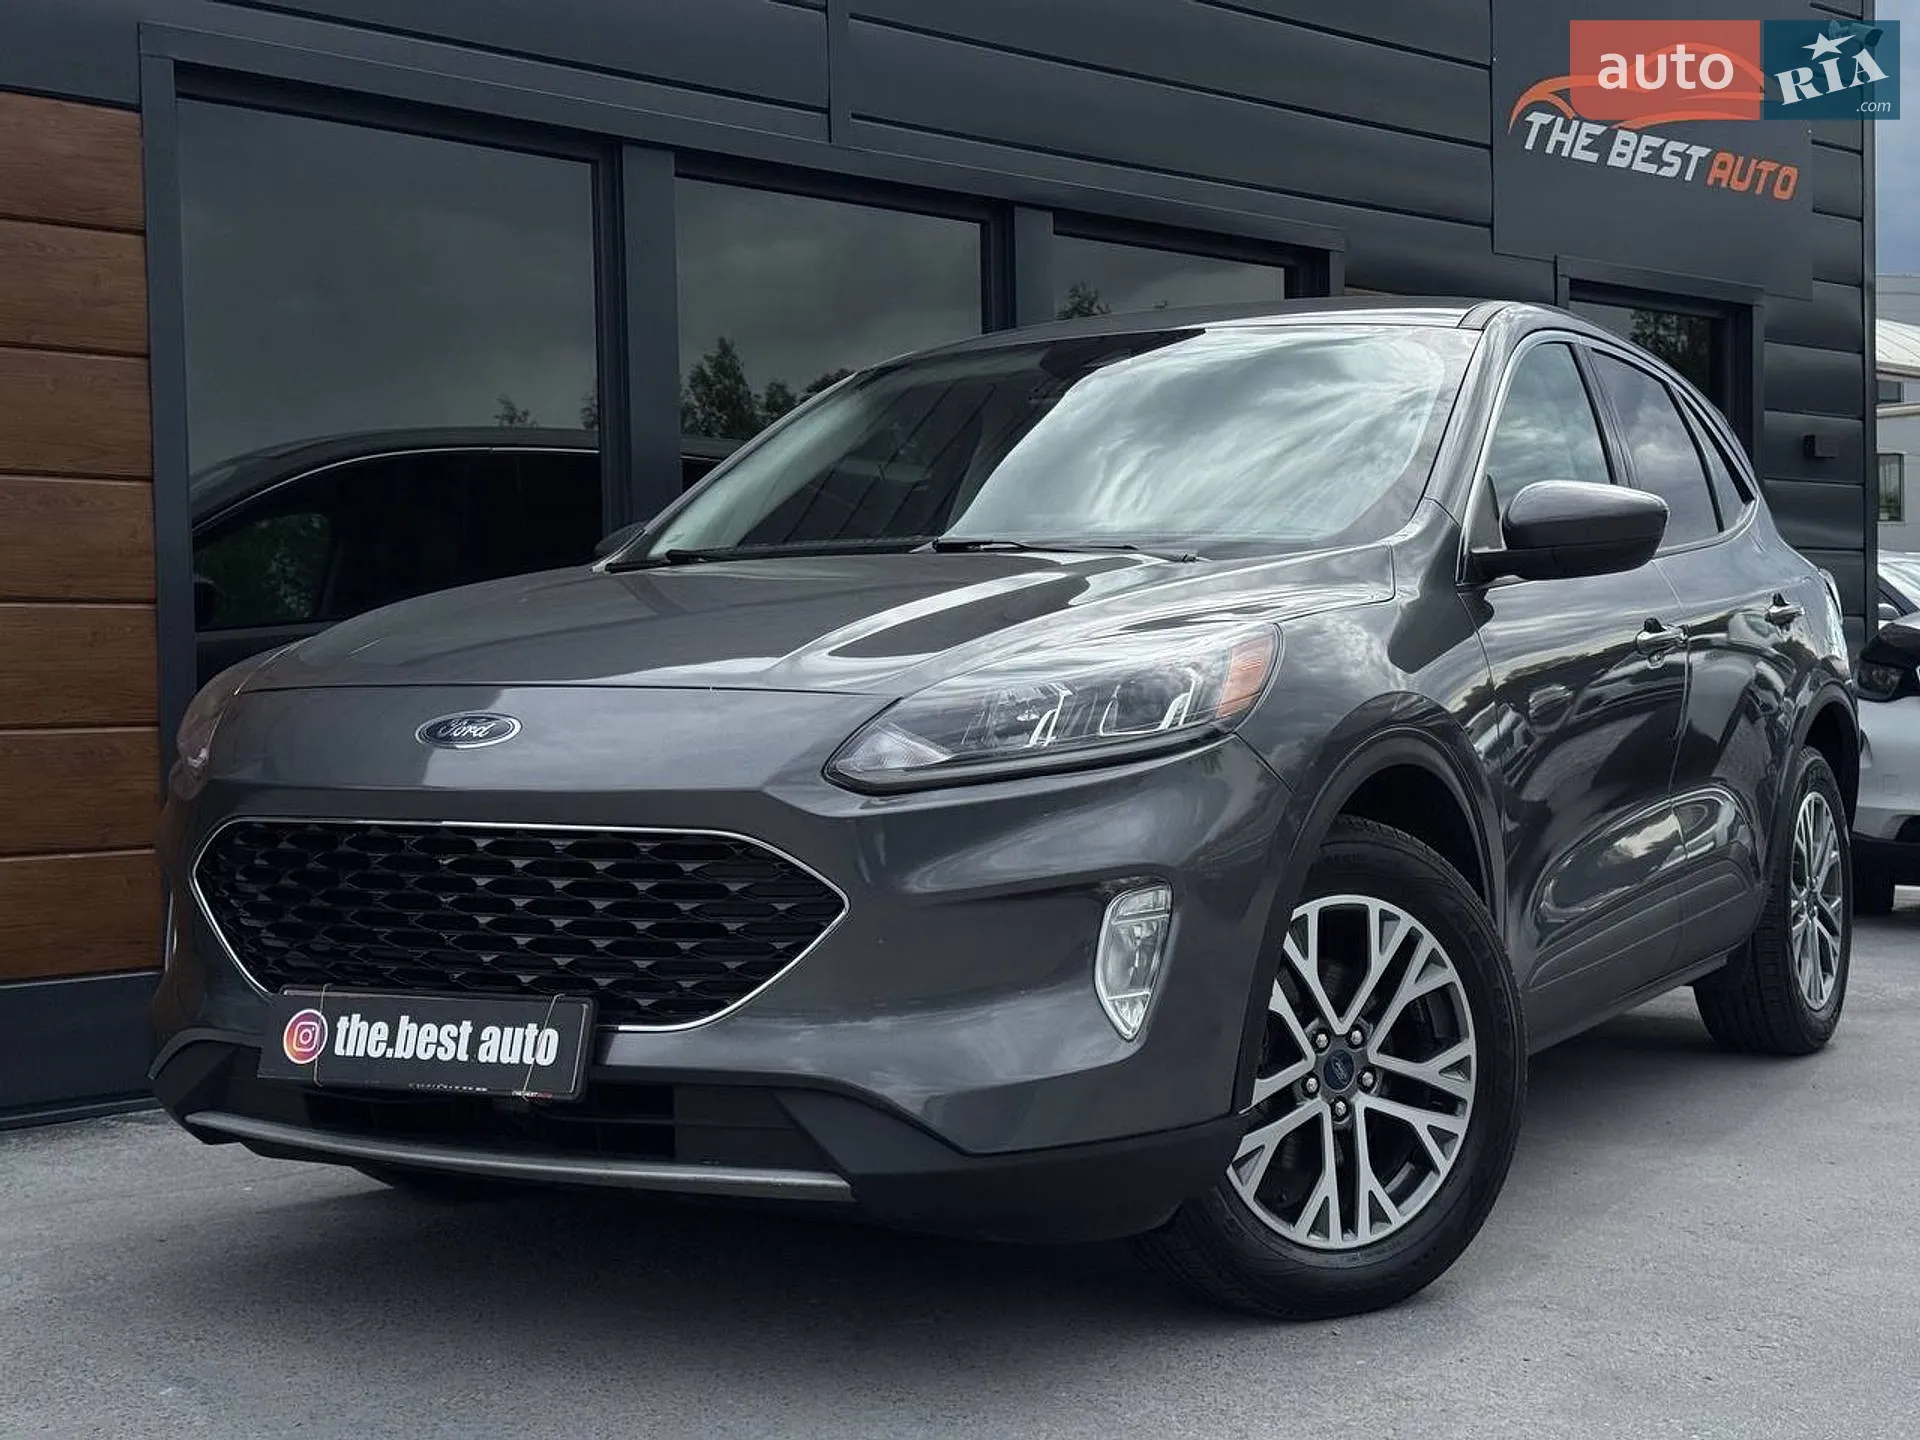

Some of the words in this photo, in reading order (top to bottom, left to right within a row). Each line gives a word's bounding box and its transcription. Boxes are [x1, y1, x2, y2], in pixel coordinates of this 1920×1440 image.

[1525, 111, 1608, 163] THE
[1607, 130, 1712, 181] BEST
[1707, 151, 1799, 201] AUTO
[438, 718, 497, 738] Ford
[334, 1014, 473, 1062] the.best
[477, 1023, 560, 1066] auto
